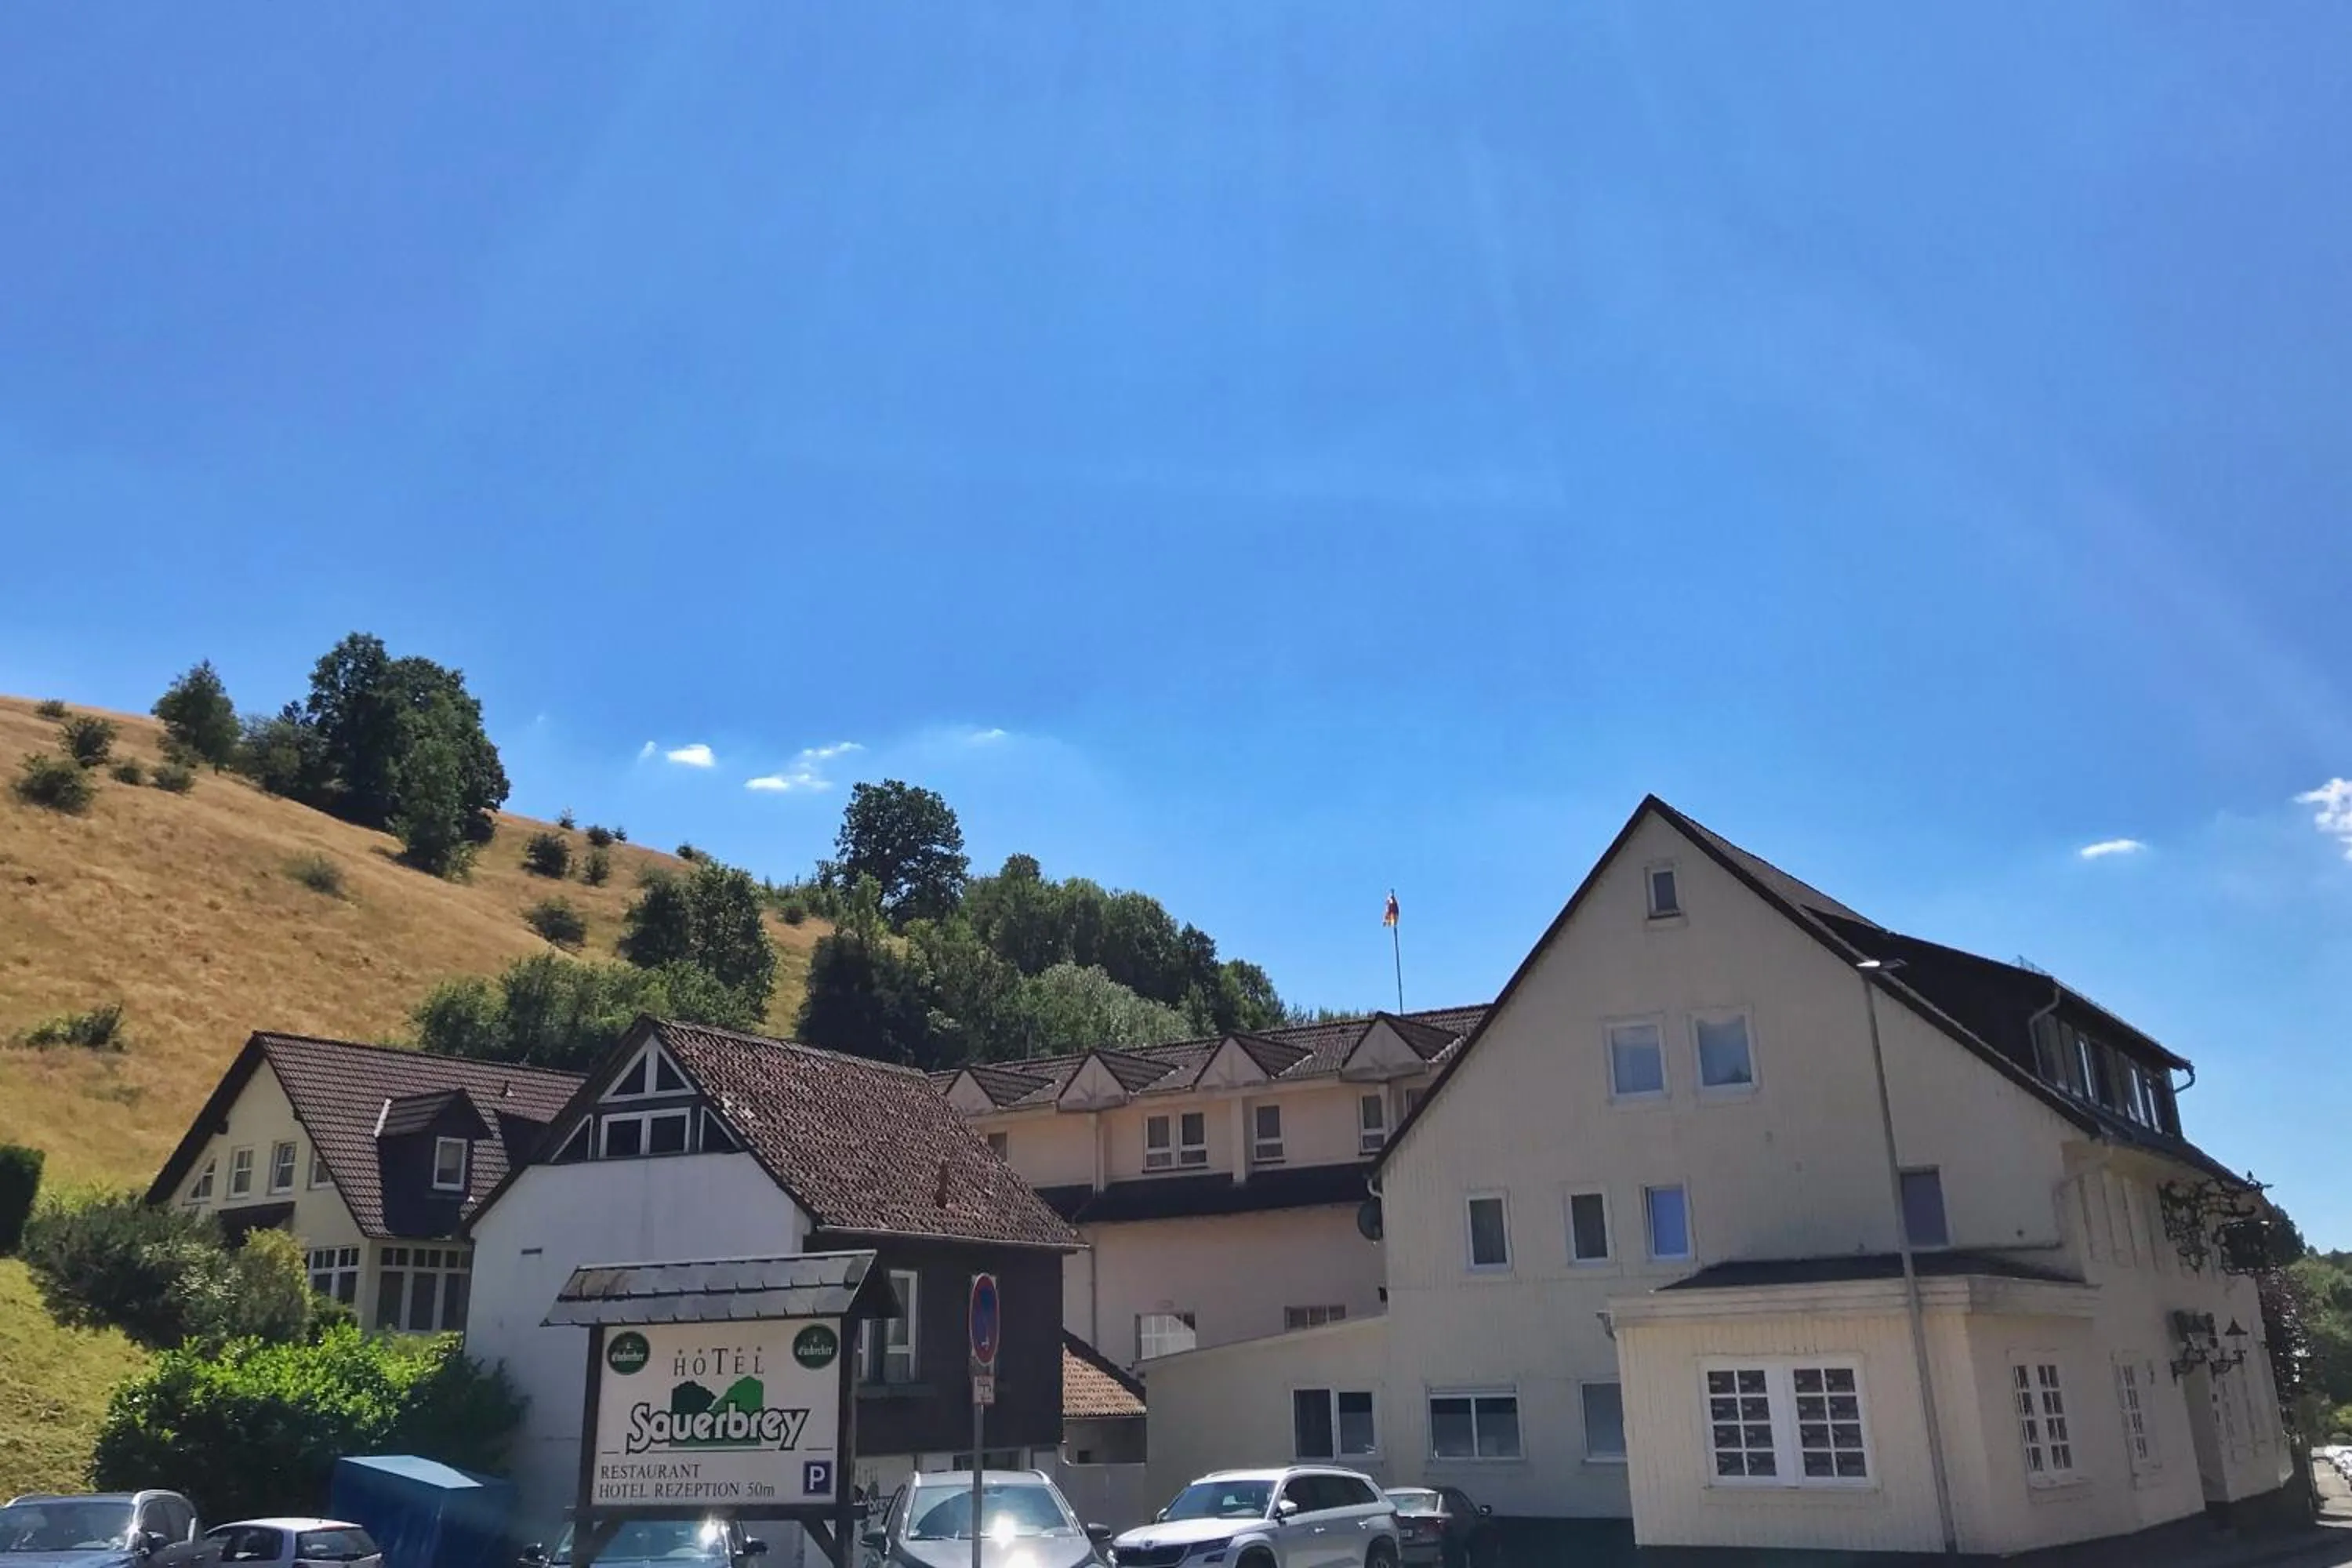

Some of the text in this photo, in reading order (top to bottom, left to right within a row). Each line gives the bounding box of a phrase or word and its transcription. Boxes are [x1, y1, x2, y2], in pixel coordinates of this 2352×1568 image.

[673, 1348, 764, 1376] HOTEL
[626, 1402, 809, 1455] Sauerbrey
[601, 1464, 701, 1479] RESTAURANT
[809, 1466, 826, 1490] P
[599, 1483, 775, 1499] HOTEL REZEPTION 50m
